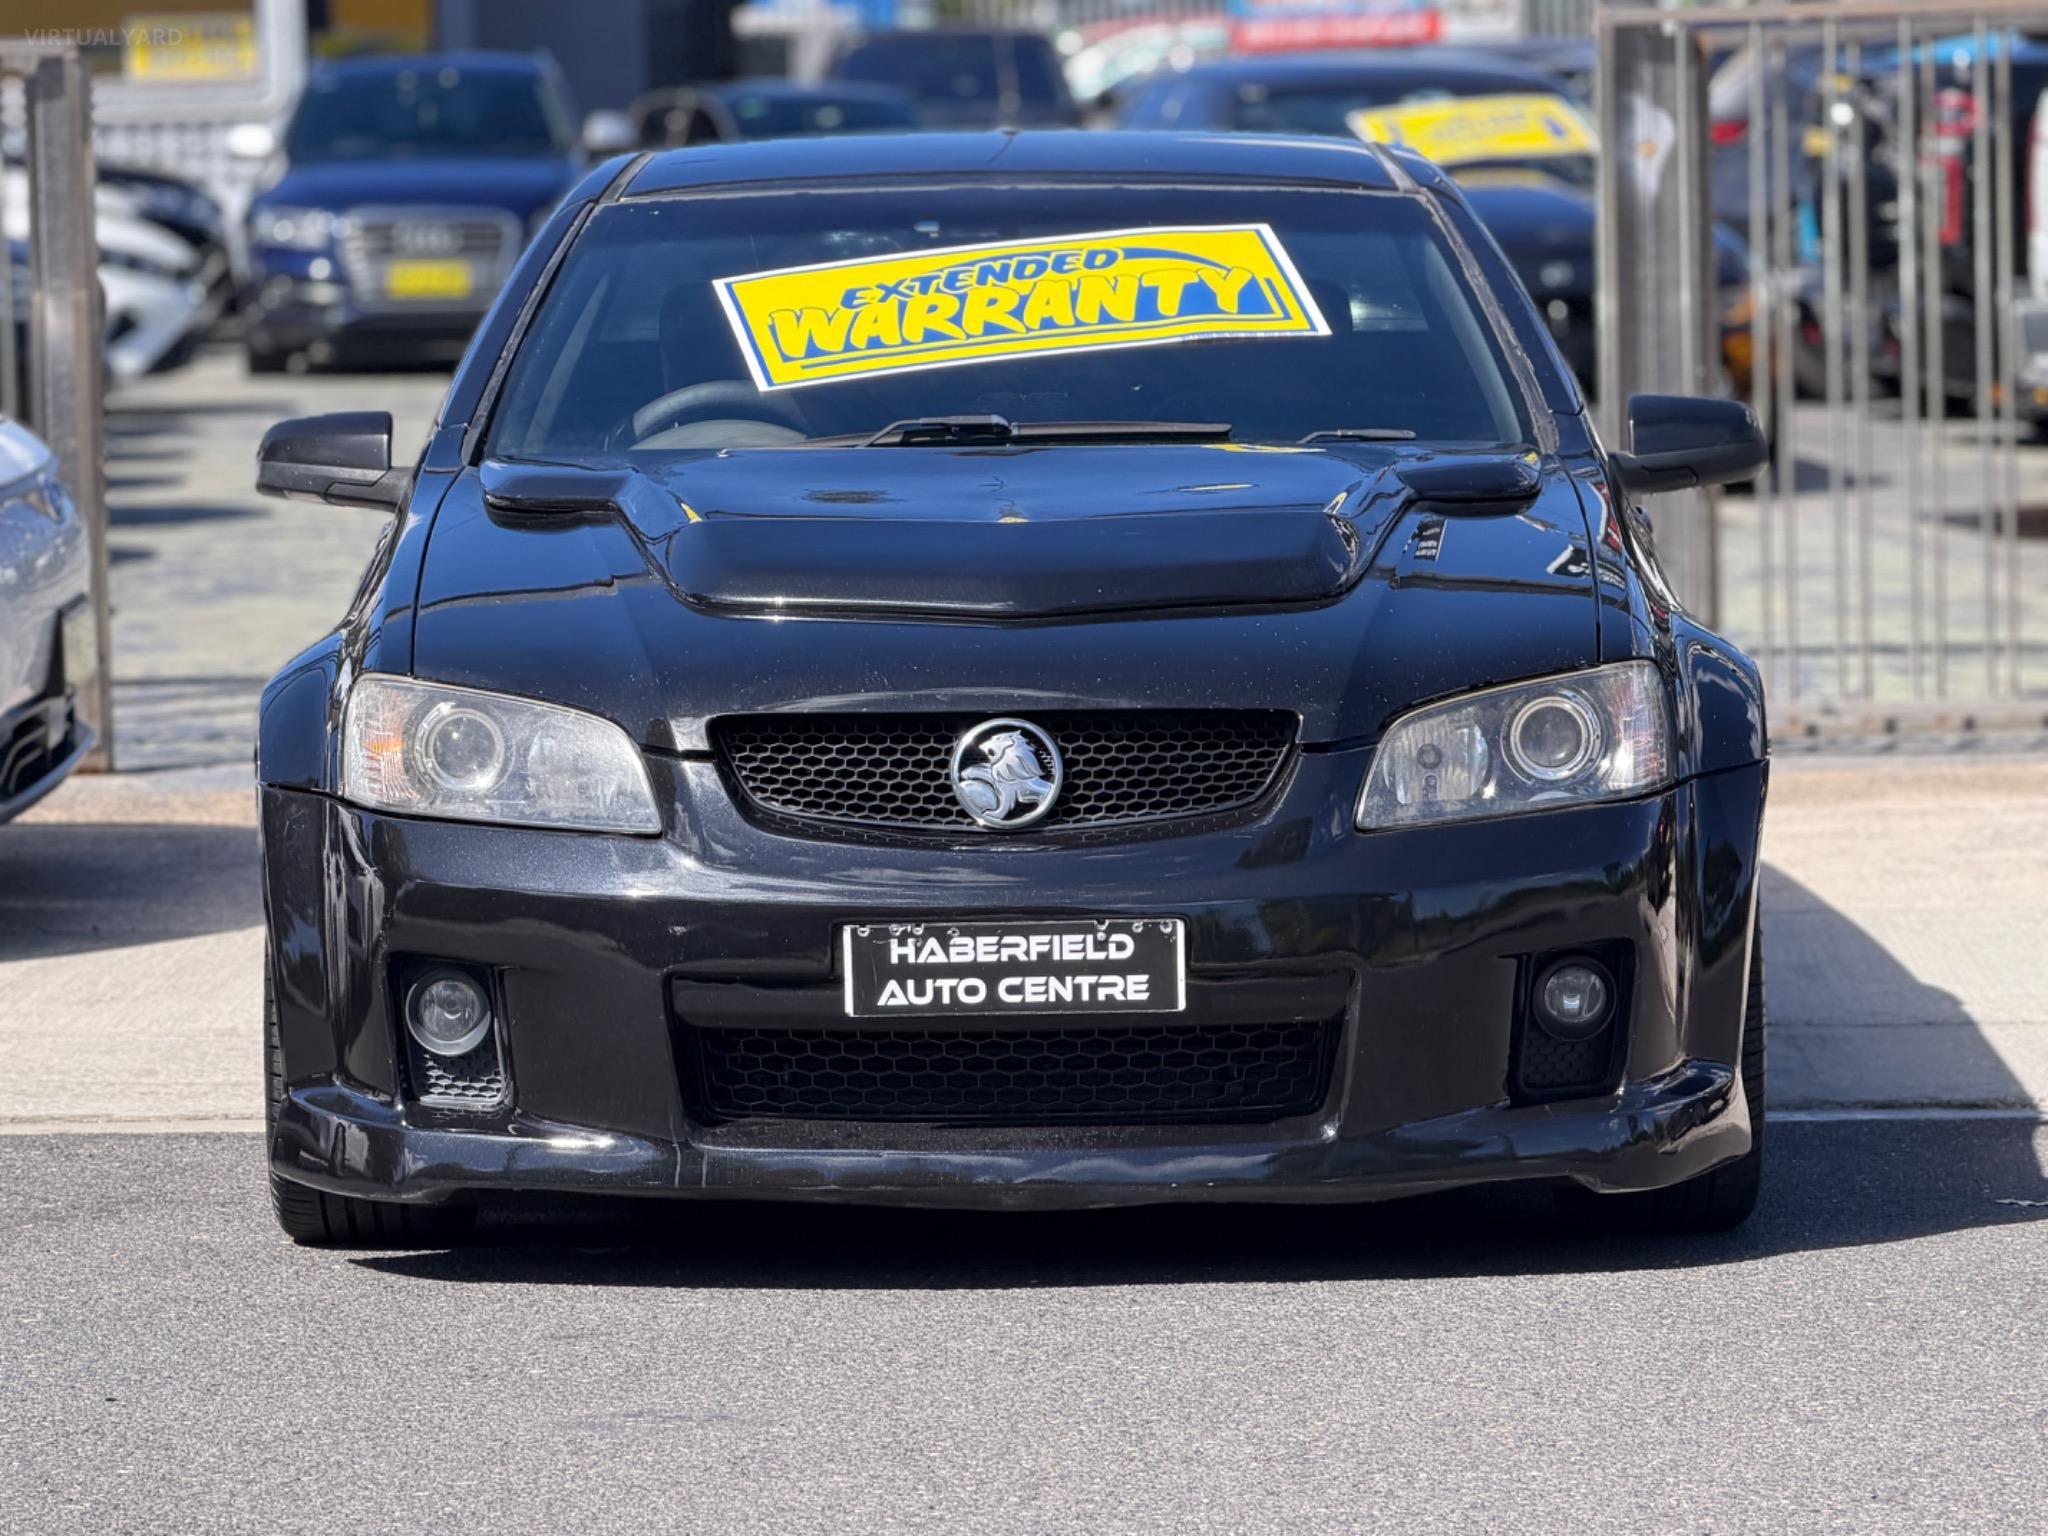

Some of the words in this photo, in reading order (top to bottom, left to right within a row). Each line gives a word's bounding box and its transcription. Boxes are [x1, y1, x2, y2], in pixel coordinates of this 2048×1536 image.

[841, 247, 1125, 310] EXTENDED
[768, 267, 1254, 359] WARRANTY
[889, 933, 1135, 964] HABERFIELD
[877, 977, 987, 1006] AUTO
[997, 974, 1150, 1003] CENTRE
